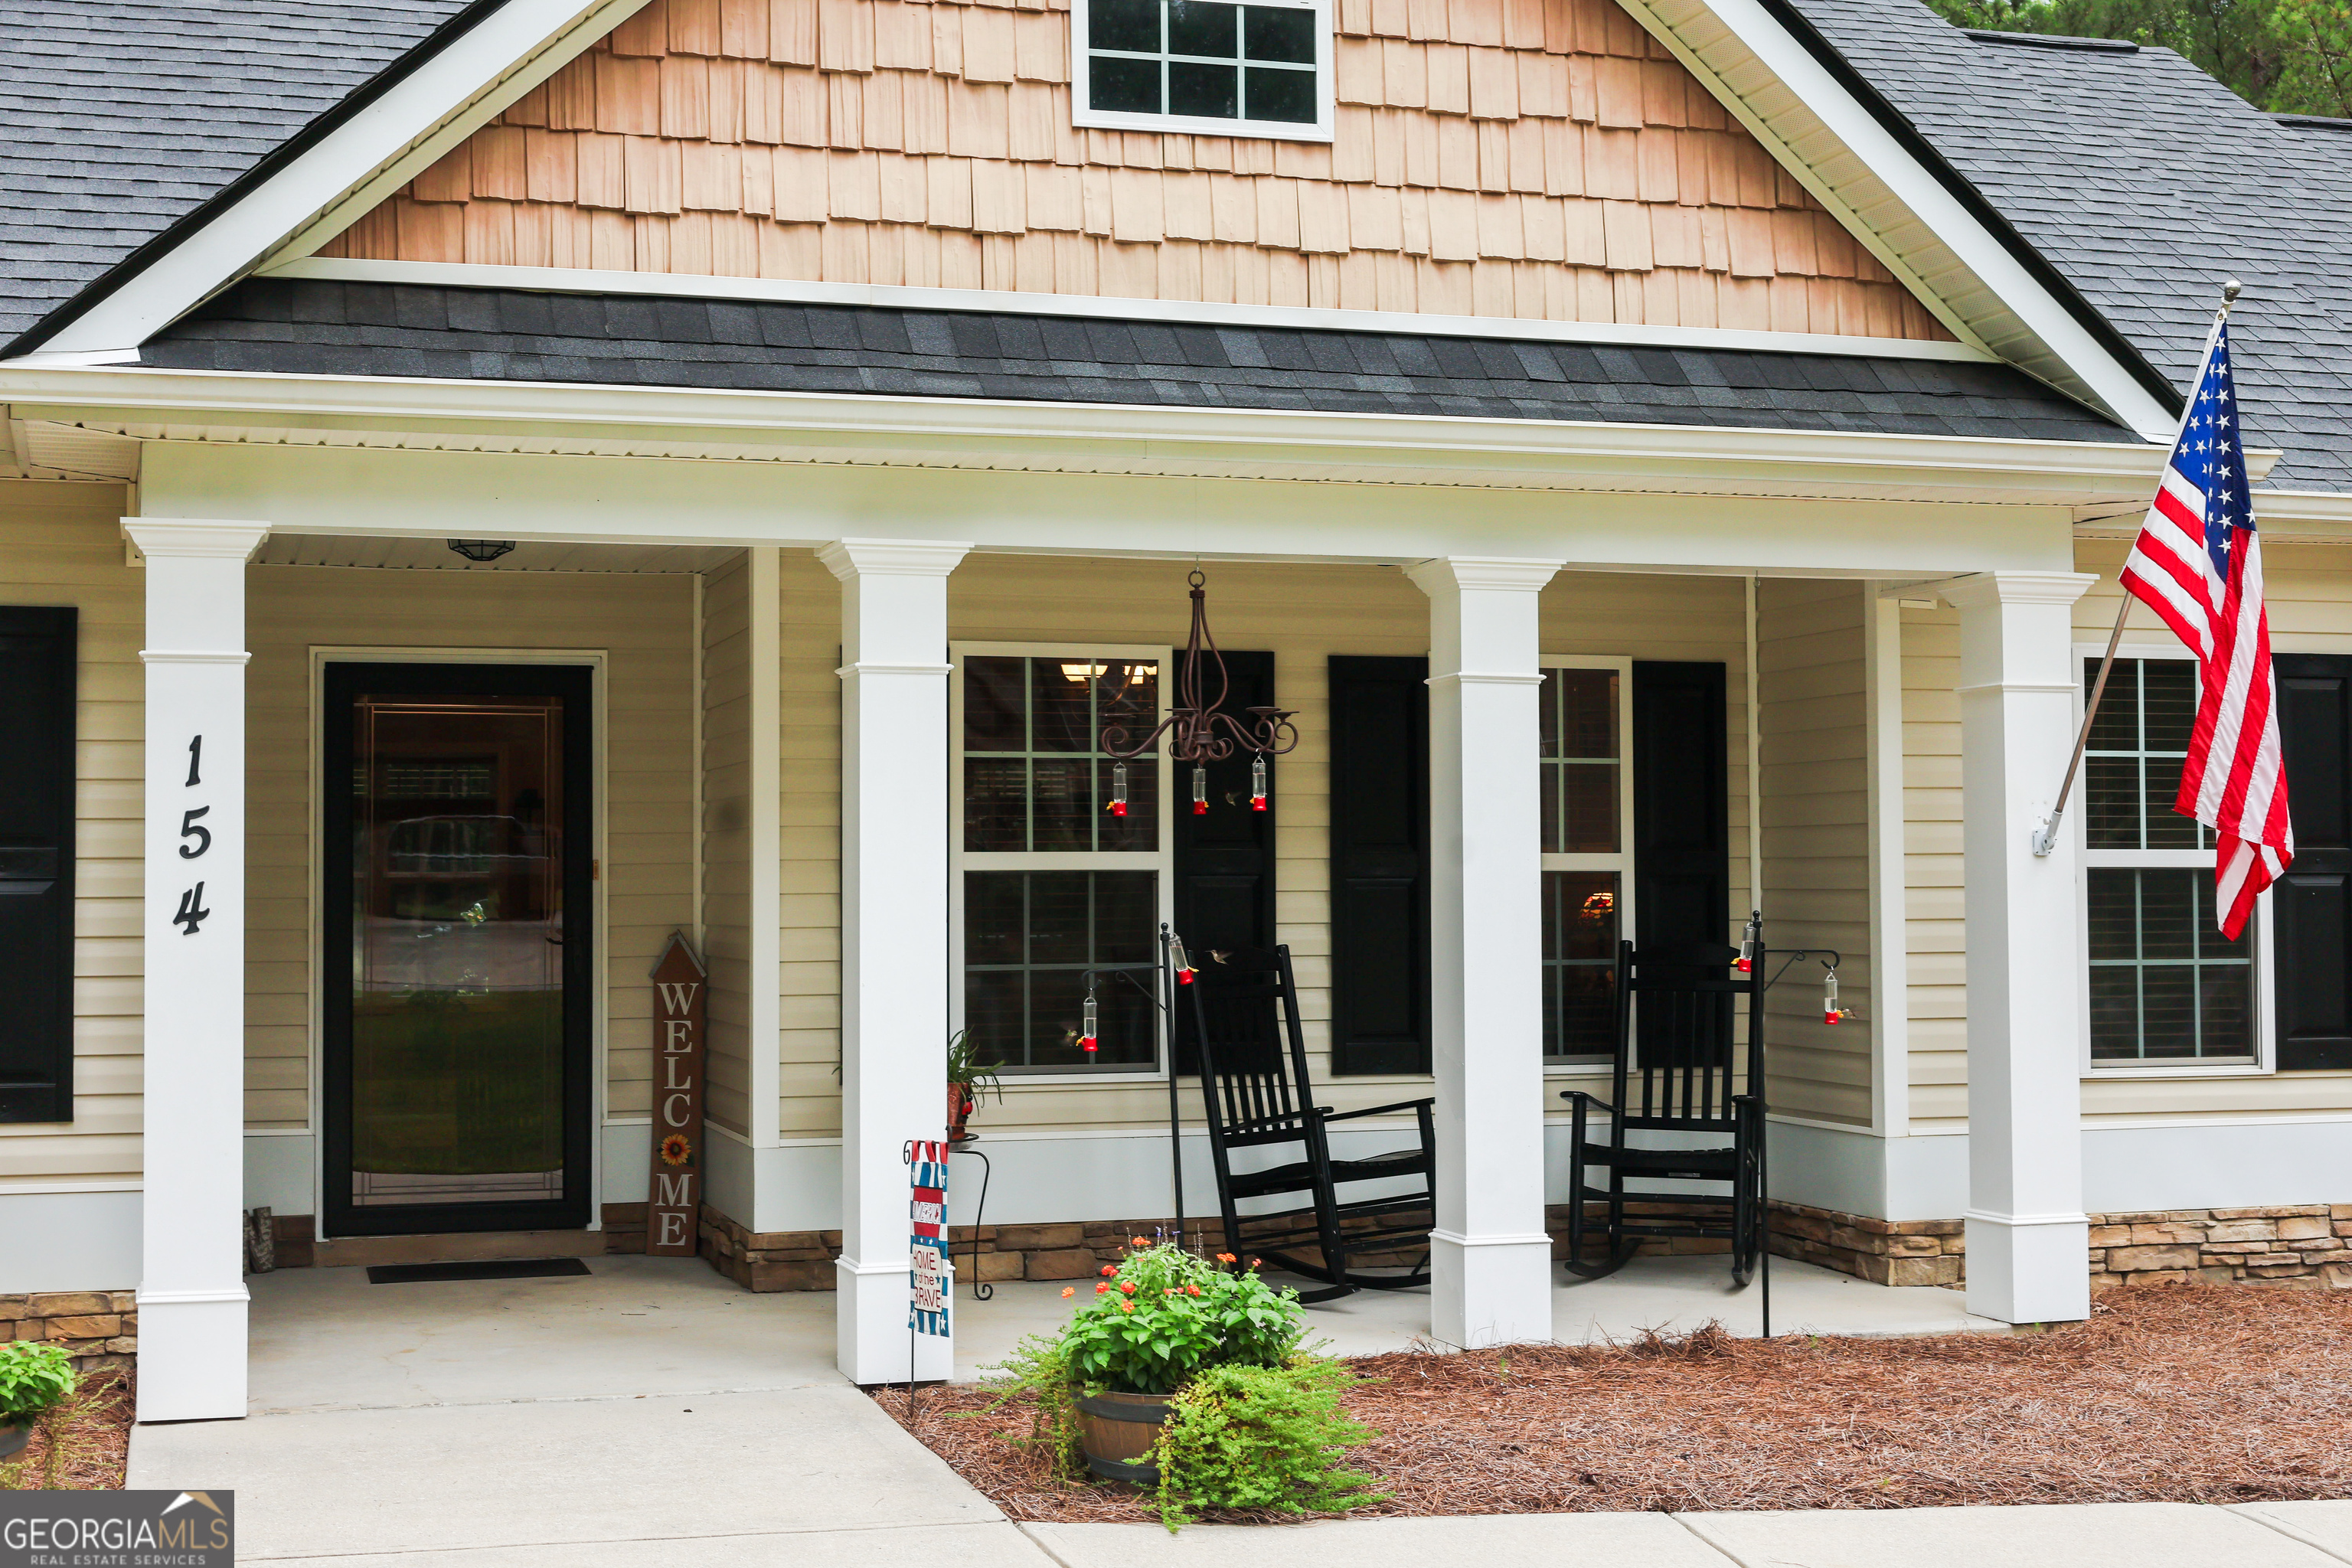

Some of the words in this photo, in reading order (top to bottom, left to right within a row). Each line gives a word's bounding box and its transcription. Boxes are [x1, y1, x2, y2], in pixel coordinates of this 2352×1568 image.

[172, 734, 211, 936] 154
[655, 983, 700, 1246] WELCME
[913, 1250, 936, 1271] HOME
[914, 1286, 941, 1308] BRAVE
